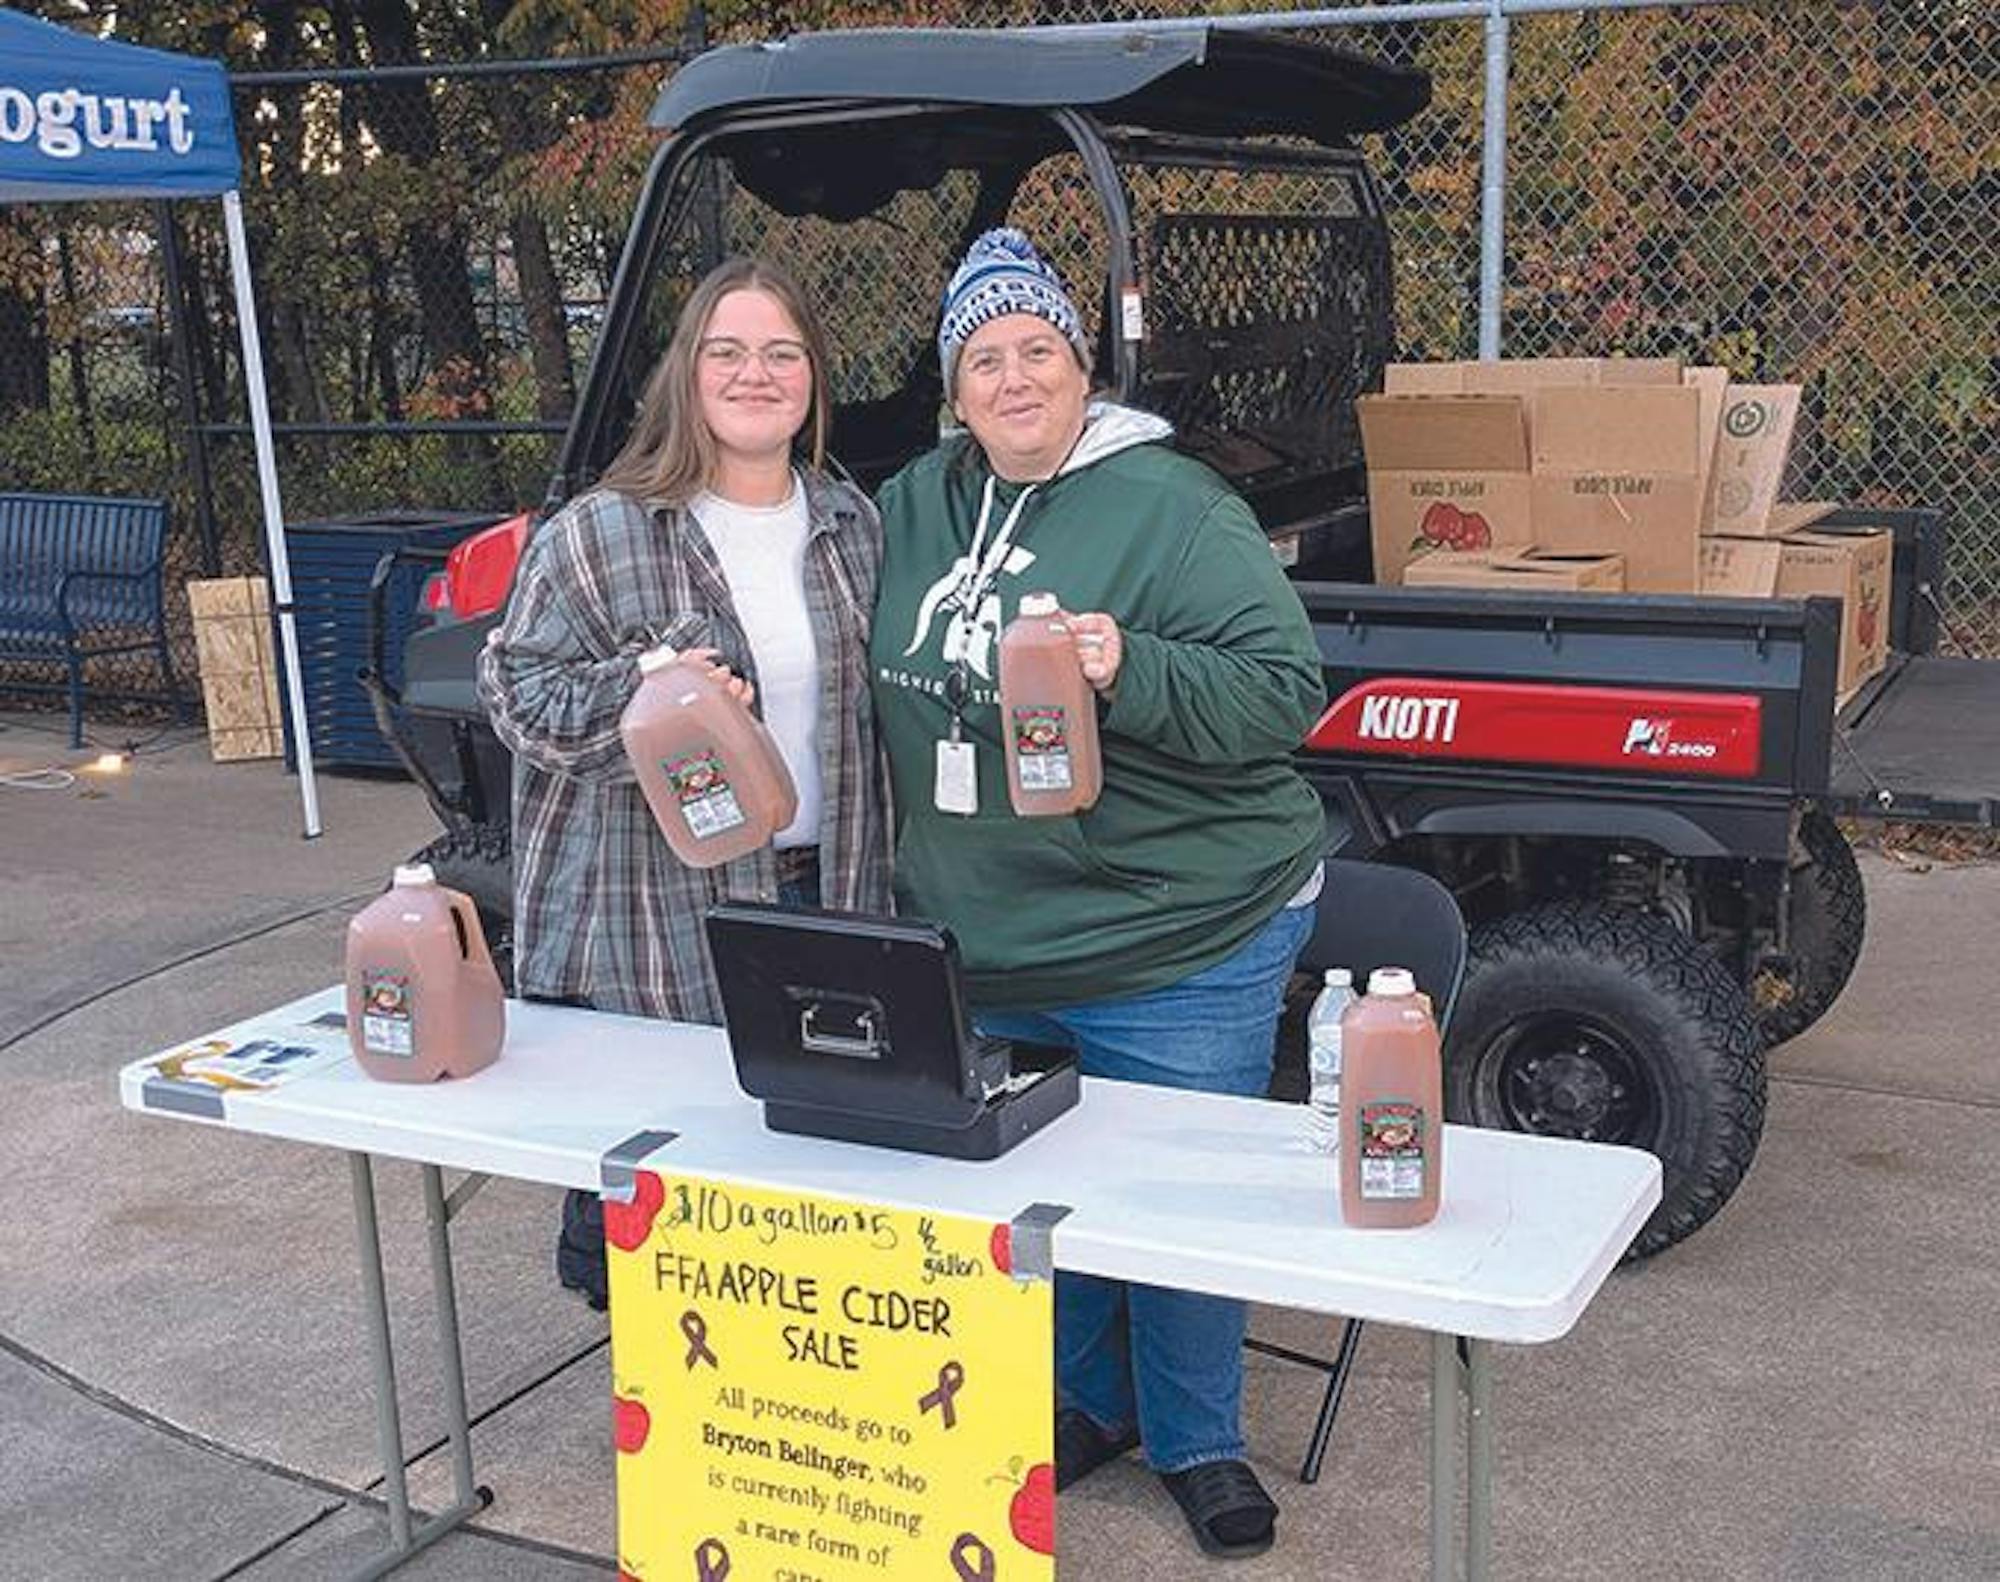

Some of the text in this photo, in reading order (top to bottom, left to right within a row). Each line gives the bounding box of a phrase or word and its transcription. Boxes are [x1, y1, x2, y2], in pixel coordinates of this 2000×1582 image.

[0, 87, 193, 158] ogurt
[1358, 695, 1460, 742] KIOTI
[739, 1203, 755, 1227] a
[758, 1200, 848, 1245] gallon
[655, 1251, 951, 1338] FFA APPLE CIDER
[921, 1253, 983, 1285] gallon
[781, 1325, 860, 1371] SALE
[714, 1386, 913, 1446] All proceeds go to
[702, 1423, 773, 1456] Bryton
[881, 1465, 928, 1495] who
[707, 1466, 923, 1539] is currently fighting
[735, 1518, 892, 1568] a rare form of
